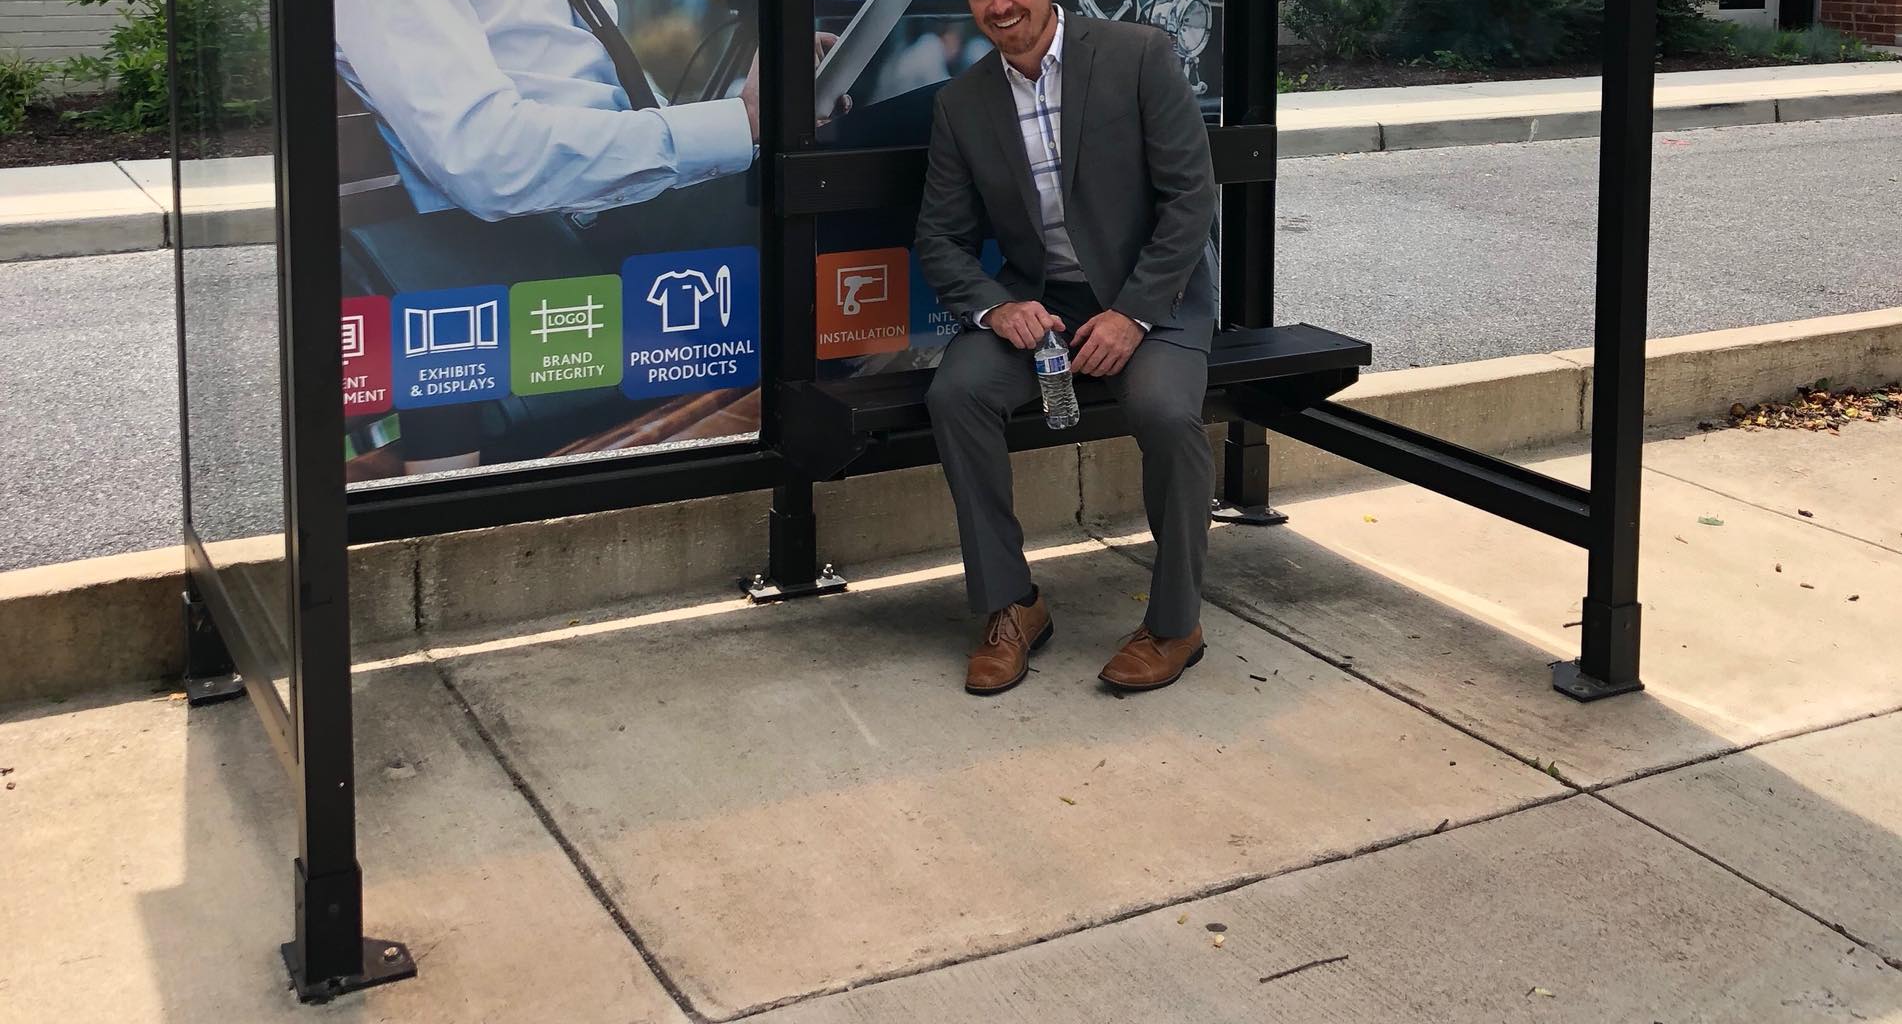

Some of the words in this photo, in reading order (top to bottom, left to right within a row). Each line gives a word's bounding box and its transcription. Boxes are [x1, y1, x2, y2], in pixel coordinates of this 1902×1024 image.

[548, 312, 587, 327] LOGO
[819, 325, 906, 344] INSTALLATION
[543, 352, 593, 367] BRAND
[630, 340, 755, 367] PROMOTIONAL
[419, 363, 487, 381] EXHIBITS
[530, 365, 606, 384] INTEGRITY
[648, 360, 738, 384] PRODUCTS
[410, 384, 422, 397] &
[426, 377, 496, 395] DISPLAYS
